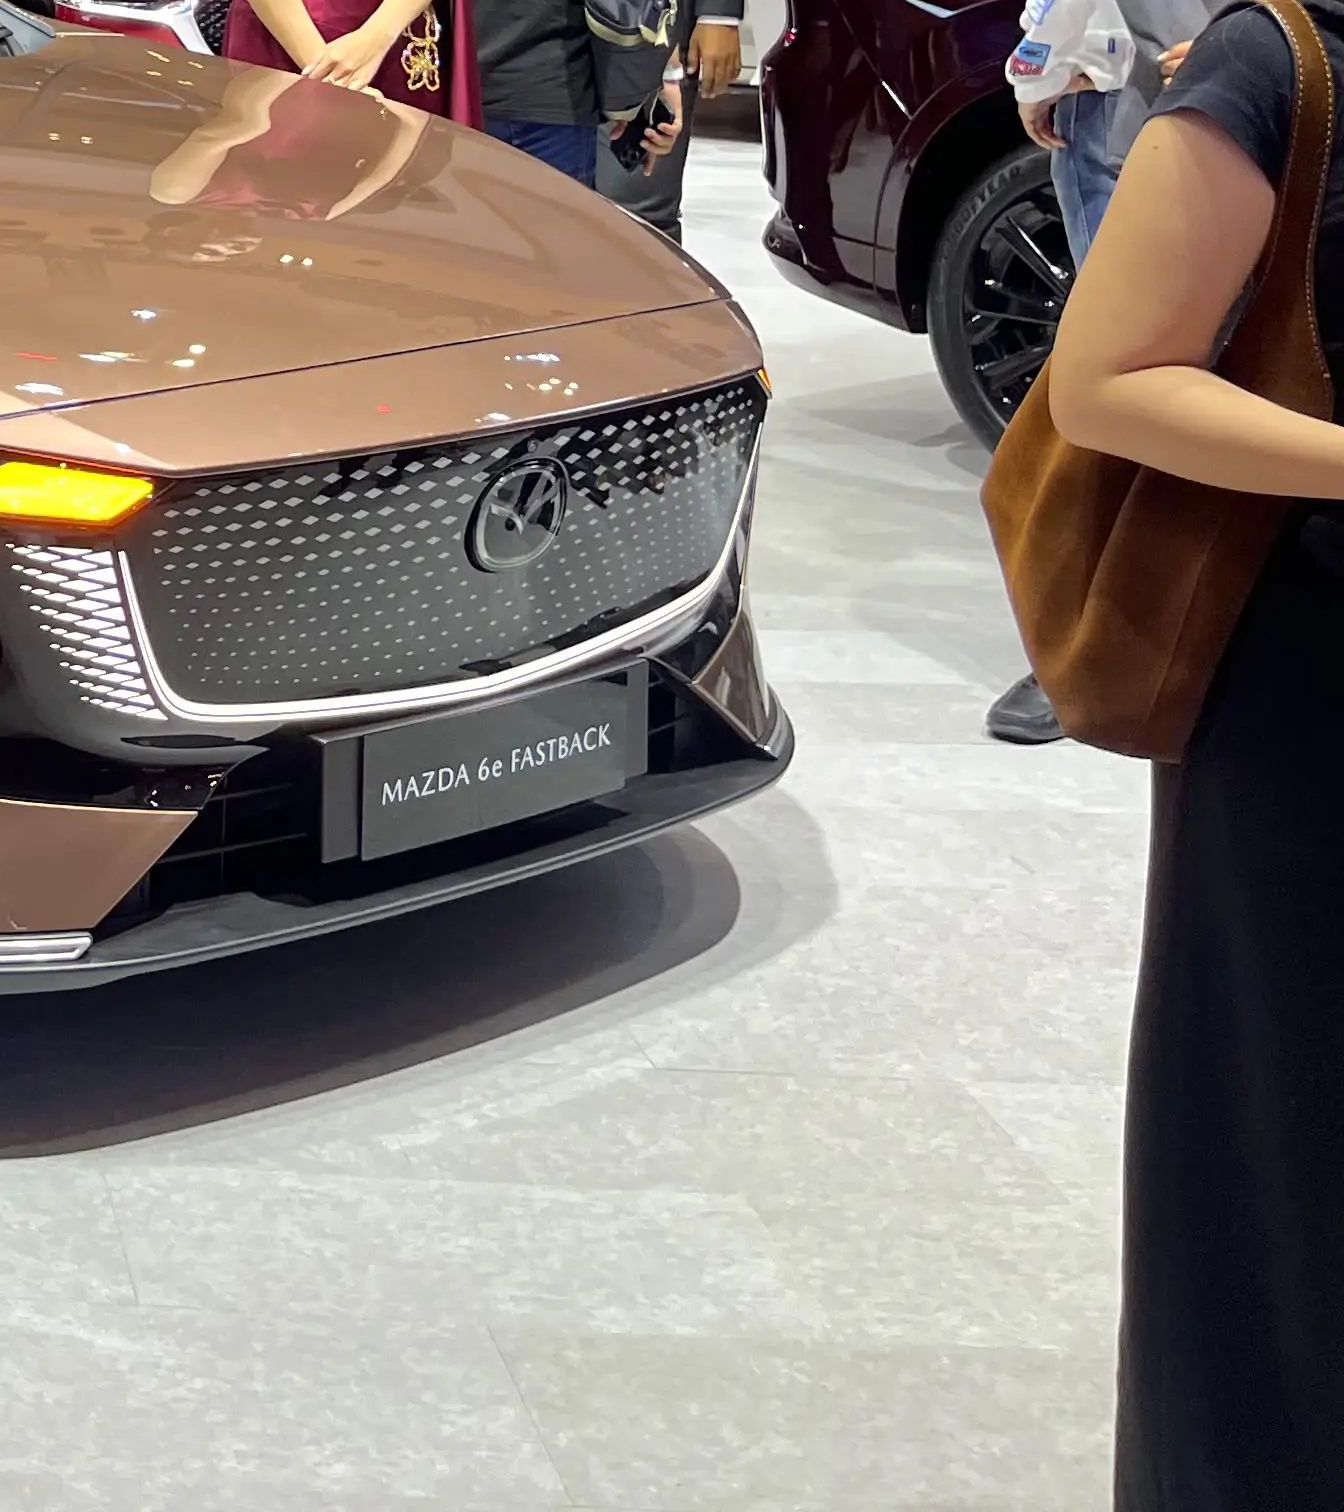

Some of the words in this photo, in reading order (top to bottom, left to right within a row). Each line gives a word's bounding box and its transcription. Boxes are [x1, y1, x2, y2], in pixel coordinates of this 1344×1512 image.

[381, 763, 470, 806] MAZDA
[477, 757, 503, 782] 6e
[510, 722, 612, 774] FASTBACK
